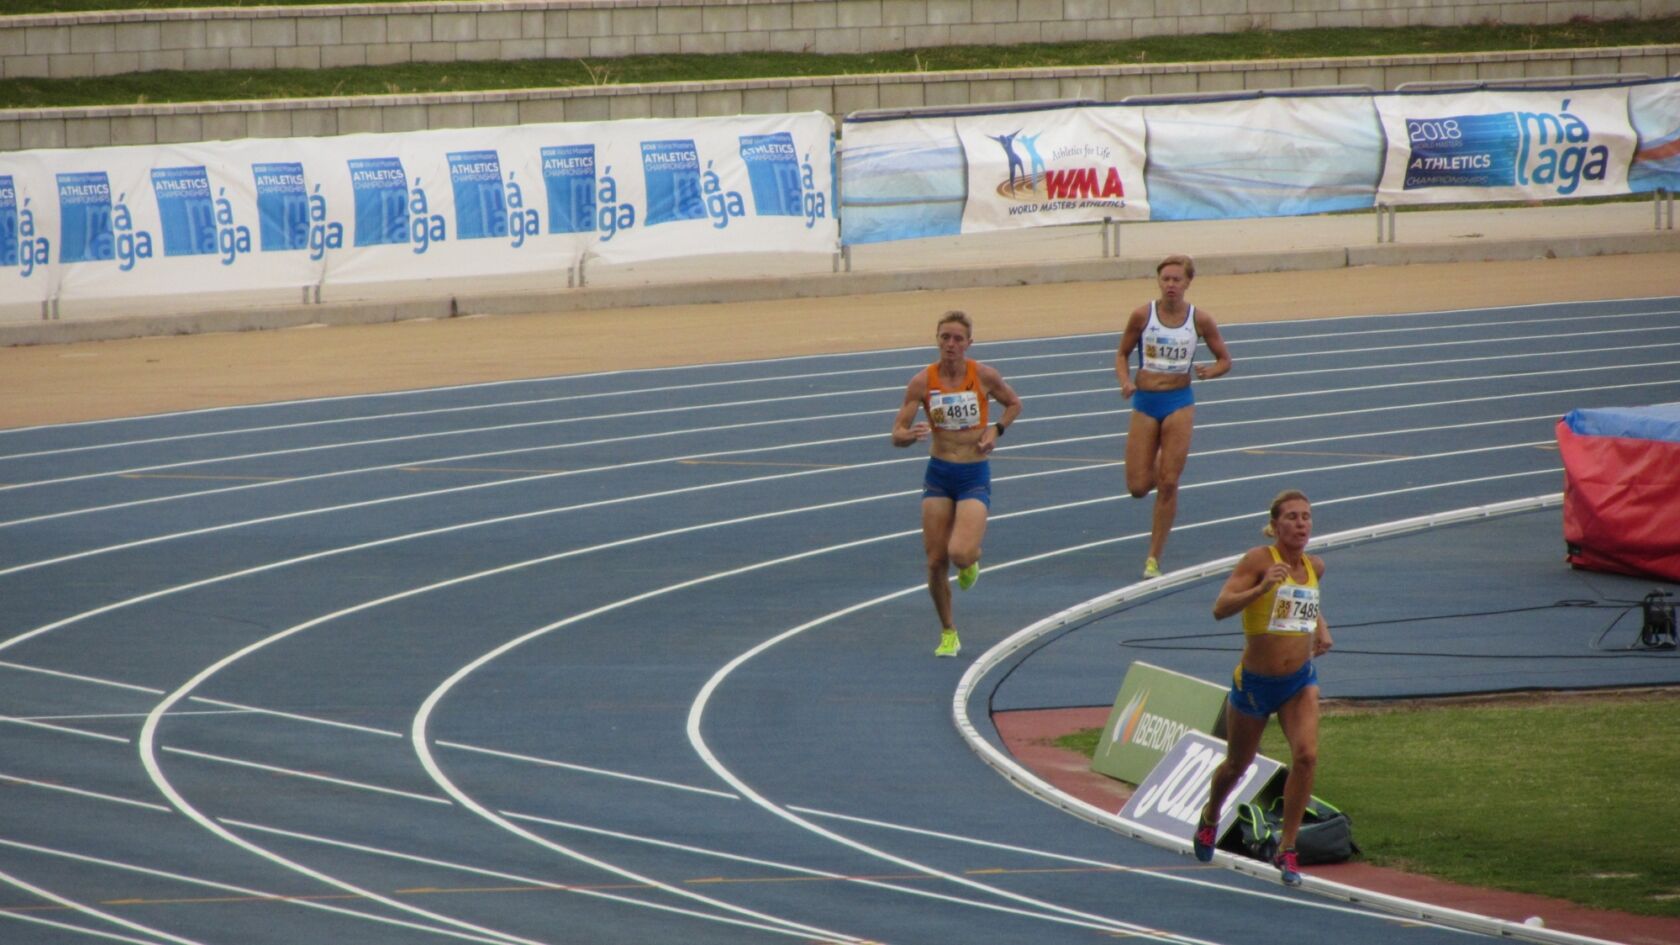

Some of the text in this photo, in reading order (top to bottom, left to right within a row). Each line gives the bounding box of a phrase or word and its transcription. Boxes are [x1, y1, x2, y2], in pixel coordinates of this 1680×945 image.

[1408, 119, 1462, 142] 2018
[645, 151, 696, 163] ATHLETICS
[1052, 147, 1083, 161] Athletics
[1096, 145, 1111, 159] Life
[451, 162, 498, 174] ATHLETICS
[544, 157, 593, 169] ATHLETICS
[1410, 154, 1491, 170] ATHLETICS
[354, 169, 403, 180] ATHLETICS
[1406, 175, 1489, 187] CHAMPIONSHIPS
[60, 184, 110, 196] ATHLETICS
[156, 178, 208, 190] ATHLETICS
[1046, 166, 1125, 200] WMA
[1008, 200, 1126, 215] WORLD MASTERS ATHLETICS
[1159, 346, 1187, 360] 1713
[947, 403, 978, 418] 4815
[1293, 601, 1319, 618] 7485
